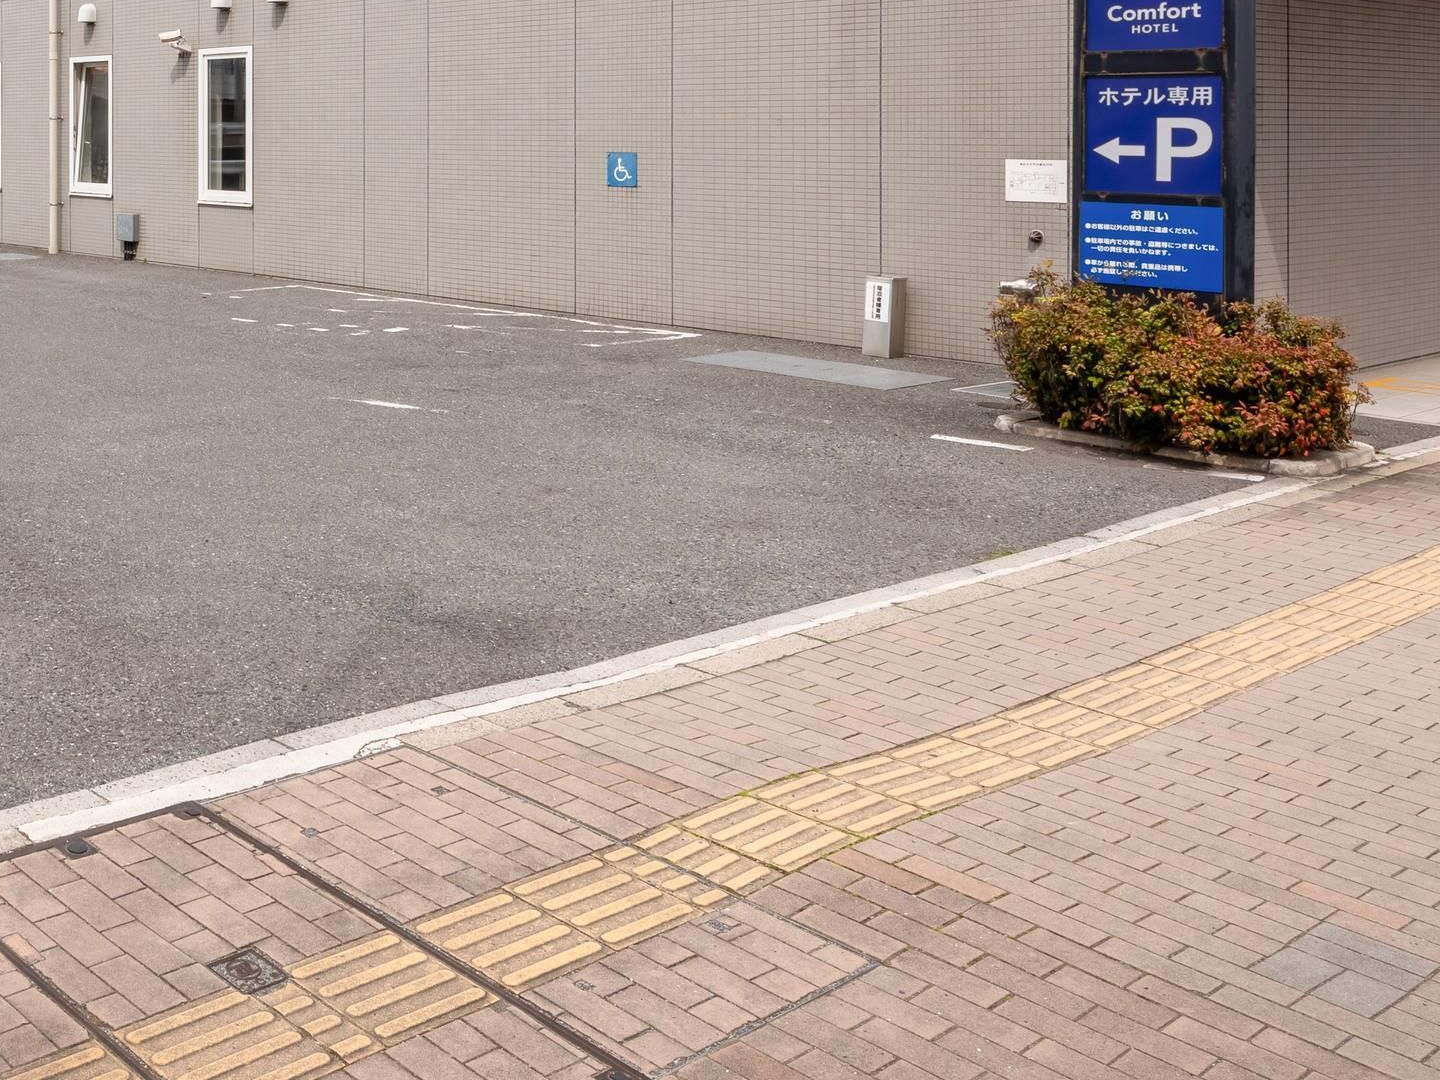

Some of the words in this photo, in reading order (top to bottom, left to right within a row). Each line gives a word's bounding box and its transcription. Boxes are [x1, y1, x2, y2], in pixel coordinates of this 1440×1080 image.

[1107, 1, 1202, 22] Comfort
[1131, 23, 1179, 34] HOTEL
[1098, 85, 1213, 106] ホテル専用
[1155, 117, 1213, 182] P
[1130, 209, 1169, 221] お願い
